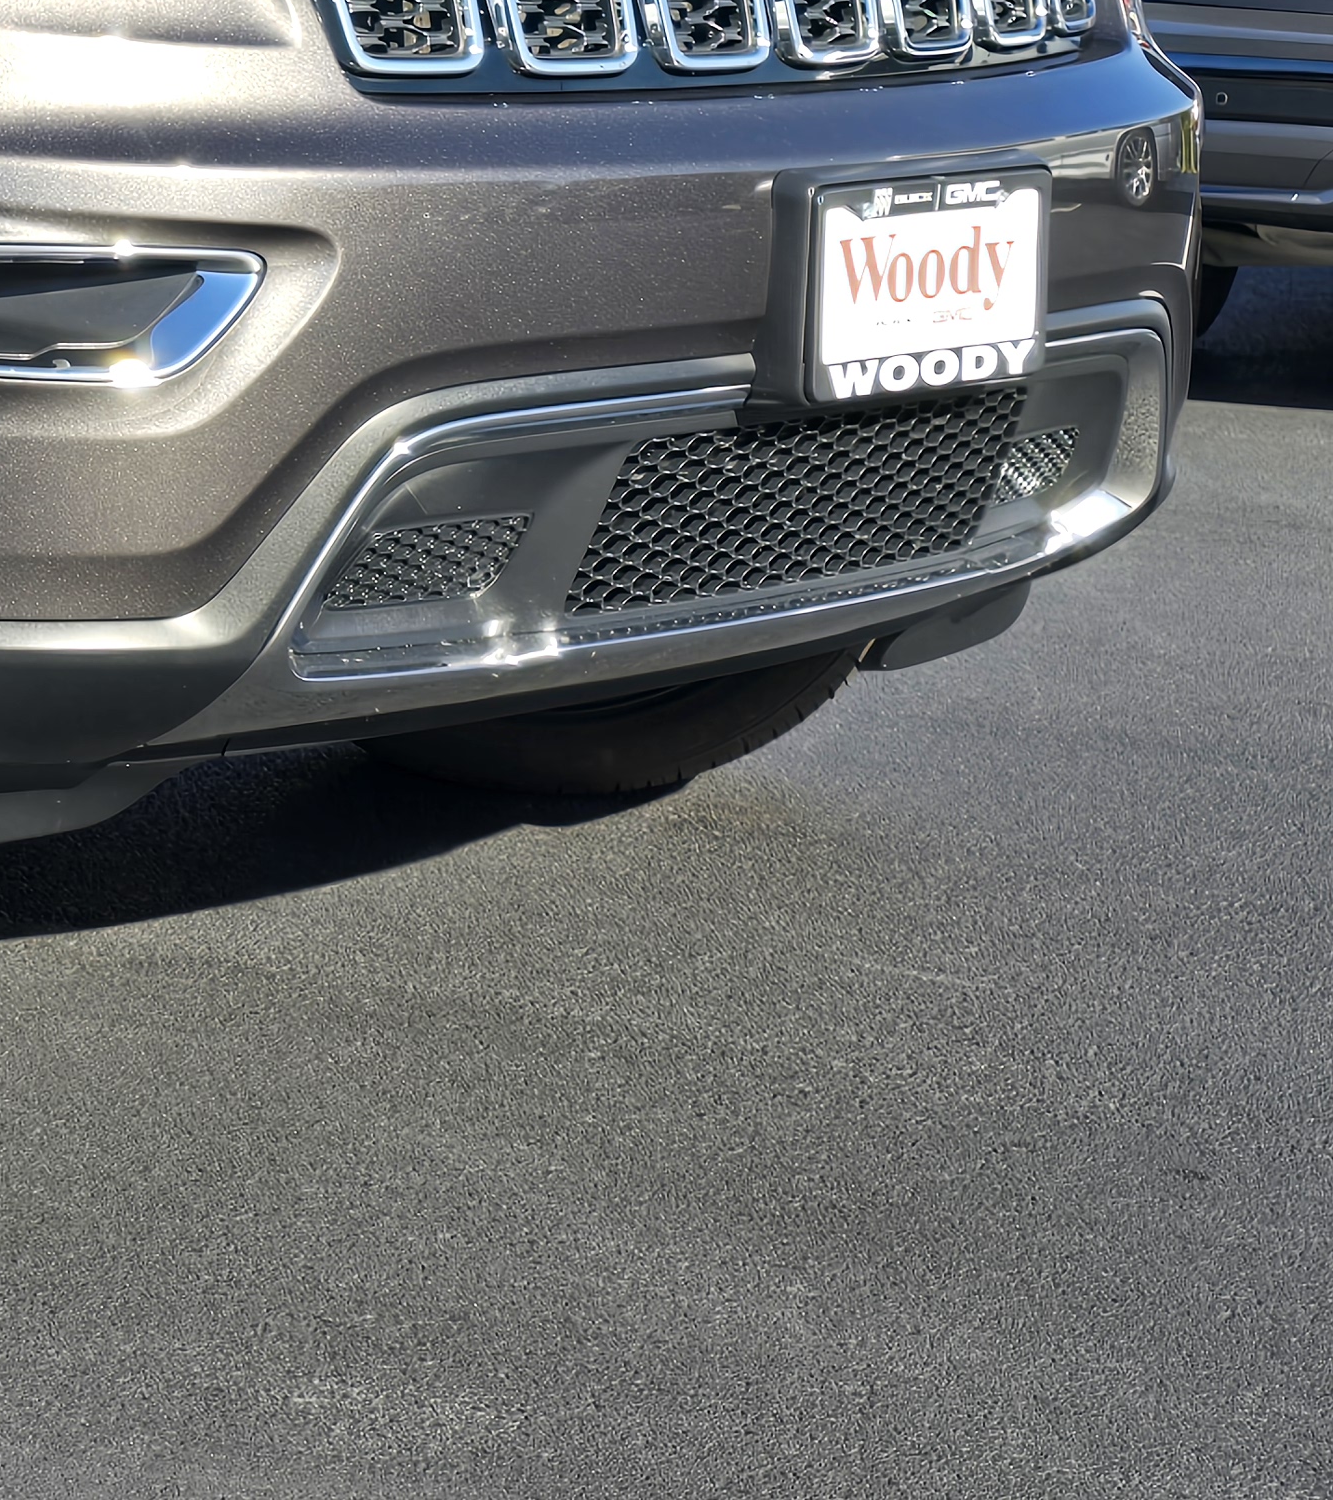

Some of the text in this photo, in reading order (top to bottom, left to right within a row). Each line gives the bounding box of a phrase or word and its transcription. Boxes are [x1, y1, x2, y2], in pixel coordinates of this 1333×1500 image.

[945, 180, 1001, 205] GMC
[839, 226, 1015, 311] Woody
[828, 339, 1035, 399] WOODY
